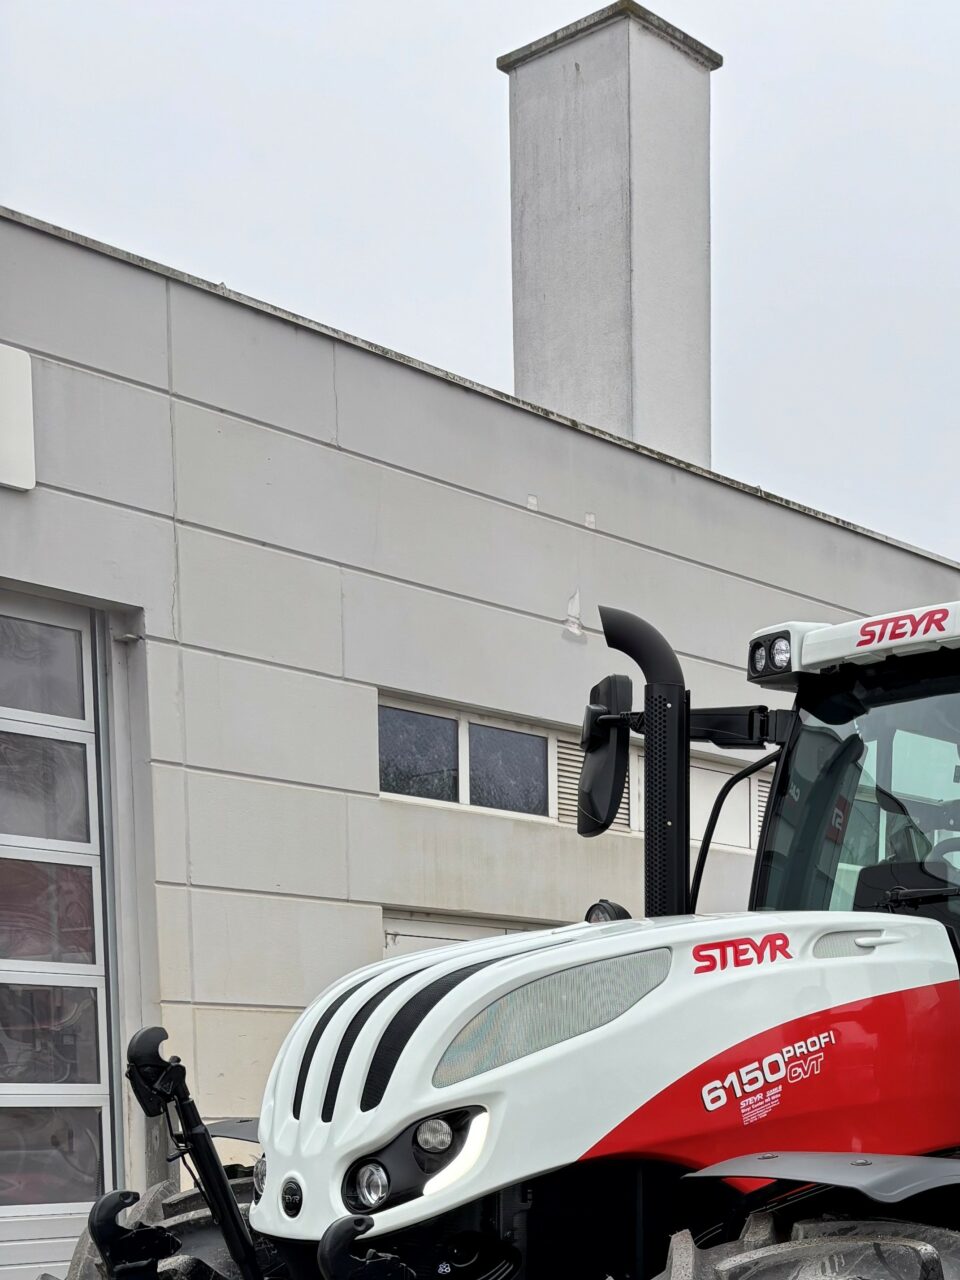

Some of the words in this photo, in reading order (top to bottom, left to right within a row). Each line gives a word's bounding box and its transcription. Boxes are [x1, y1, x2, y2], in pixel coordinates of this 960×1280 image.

[856, 608, 949, 647] STEYR
[692, 932, 794, 975] STEYR
[701, 1052, 787, 1112] 6150
[782, 1030, 836, 1062] PROFI
[787, 1052, 824, 1084] CVT
[740, 1092, 764, 1109] STEYR
